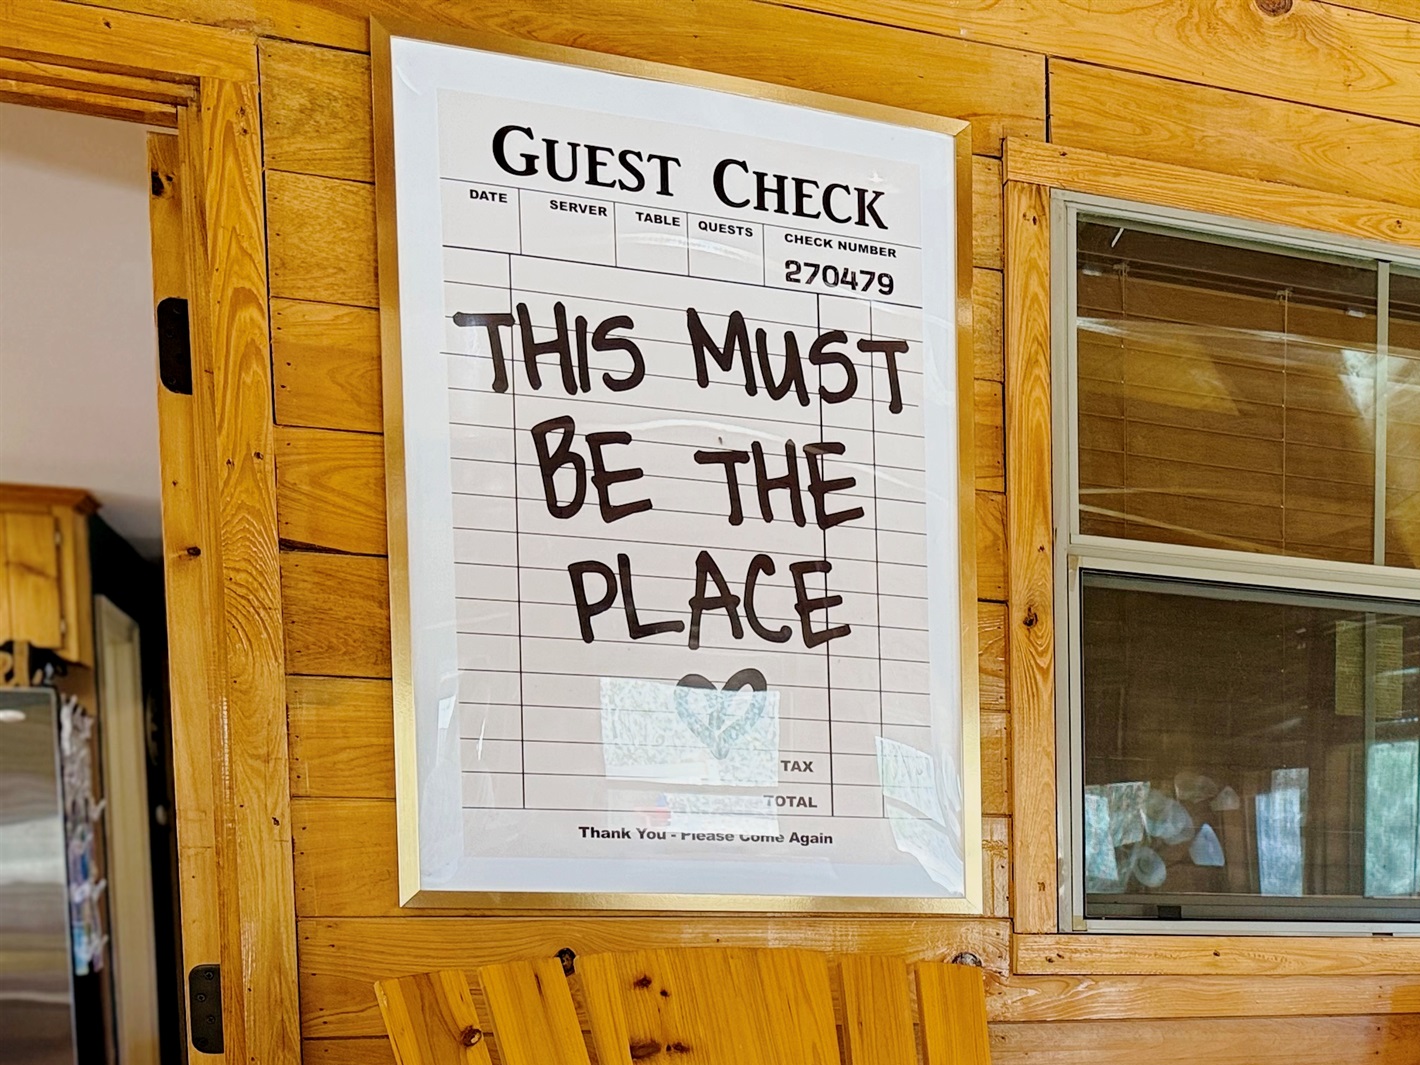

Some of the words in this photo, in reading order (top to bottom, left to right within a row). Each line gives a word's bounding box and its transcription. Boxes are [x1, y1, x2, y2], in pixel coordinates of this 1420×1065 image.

[469, 188, 508, 204] DATE
[549, 199, 608, 217] SERVER
[635, 211, 681, 228] TABLE
[698, 220, 753, 237] QUESTS
[784, 233, 834, 249] CHECK
[838, 240, 897, 258] NUMBER
[784, 259, 895, 296] 270479
[453, 301, 646, 395] THIS
[686, 307, 910, 414] MUST
[530, 415, 653, 524] BE
[694, 438, 865, 530] THE
[567, 550, 851, 650] PLACE
[780, 760, 814, 773] TAX
[763, 795, 818, 808] TOTAL
[578, 826, 631, 839] Thank
[636, 827, 666, 840] You
[789, 832, 834, 846] Again
